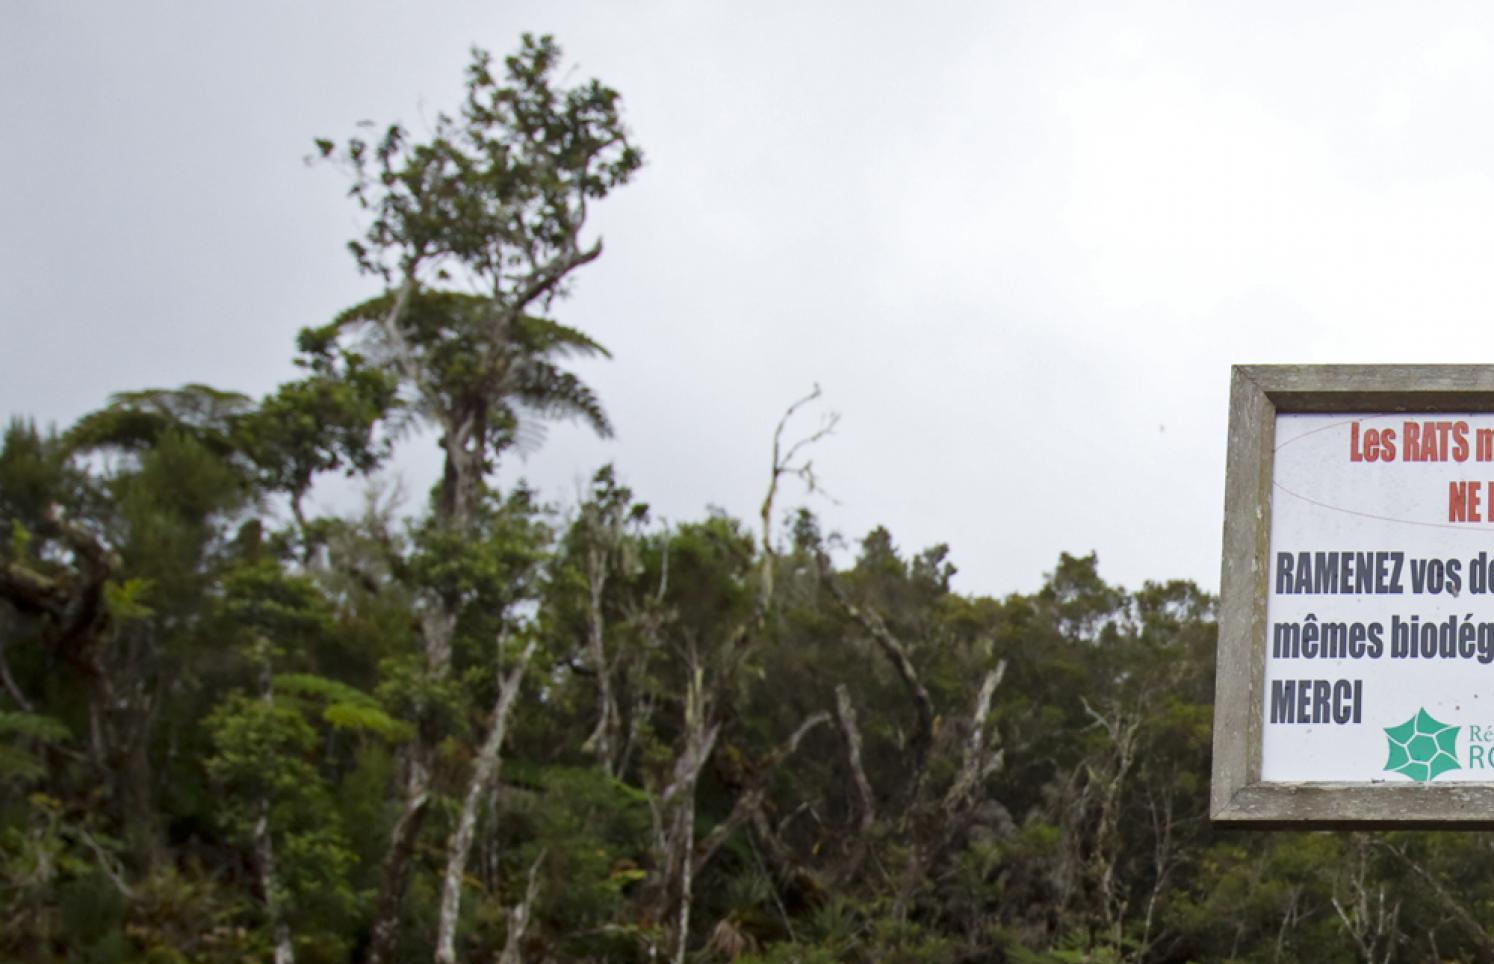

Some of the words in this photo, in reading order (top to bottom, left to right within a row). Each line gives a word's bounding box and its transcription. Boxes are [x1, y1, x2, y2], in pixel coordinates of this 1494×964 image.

[1350, 422, 1396, 462] Les
[1402, 421, 1469, 463] RATS
[1448, 481, 1481, 523] NE
[1275, 551, 1405, 595] RAMENEZ
[1410, 558, 1461, 596] vos
[1272, 613, 1384, 659] mêmes
[1270, 679, 1363, 725] MERCI
